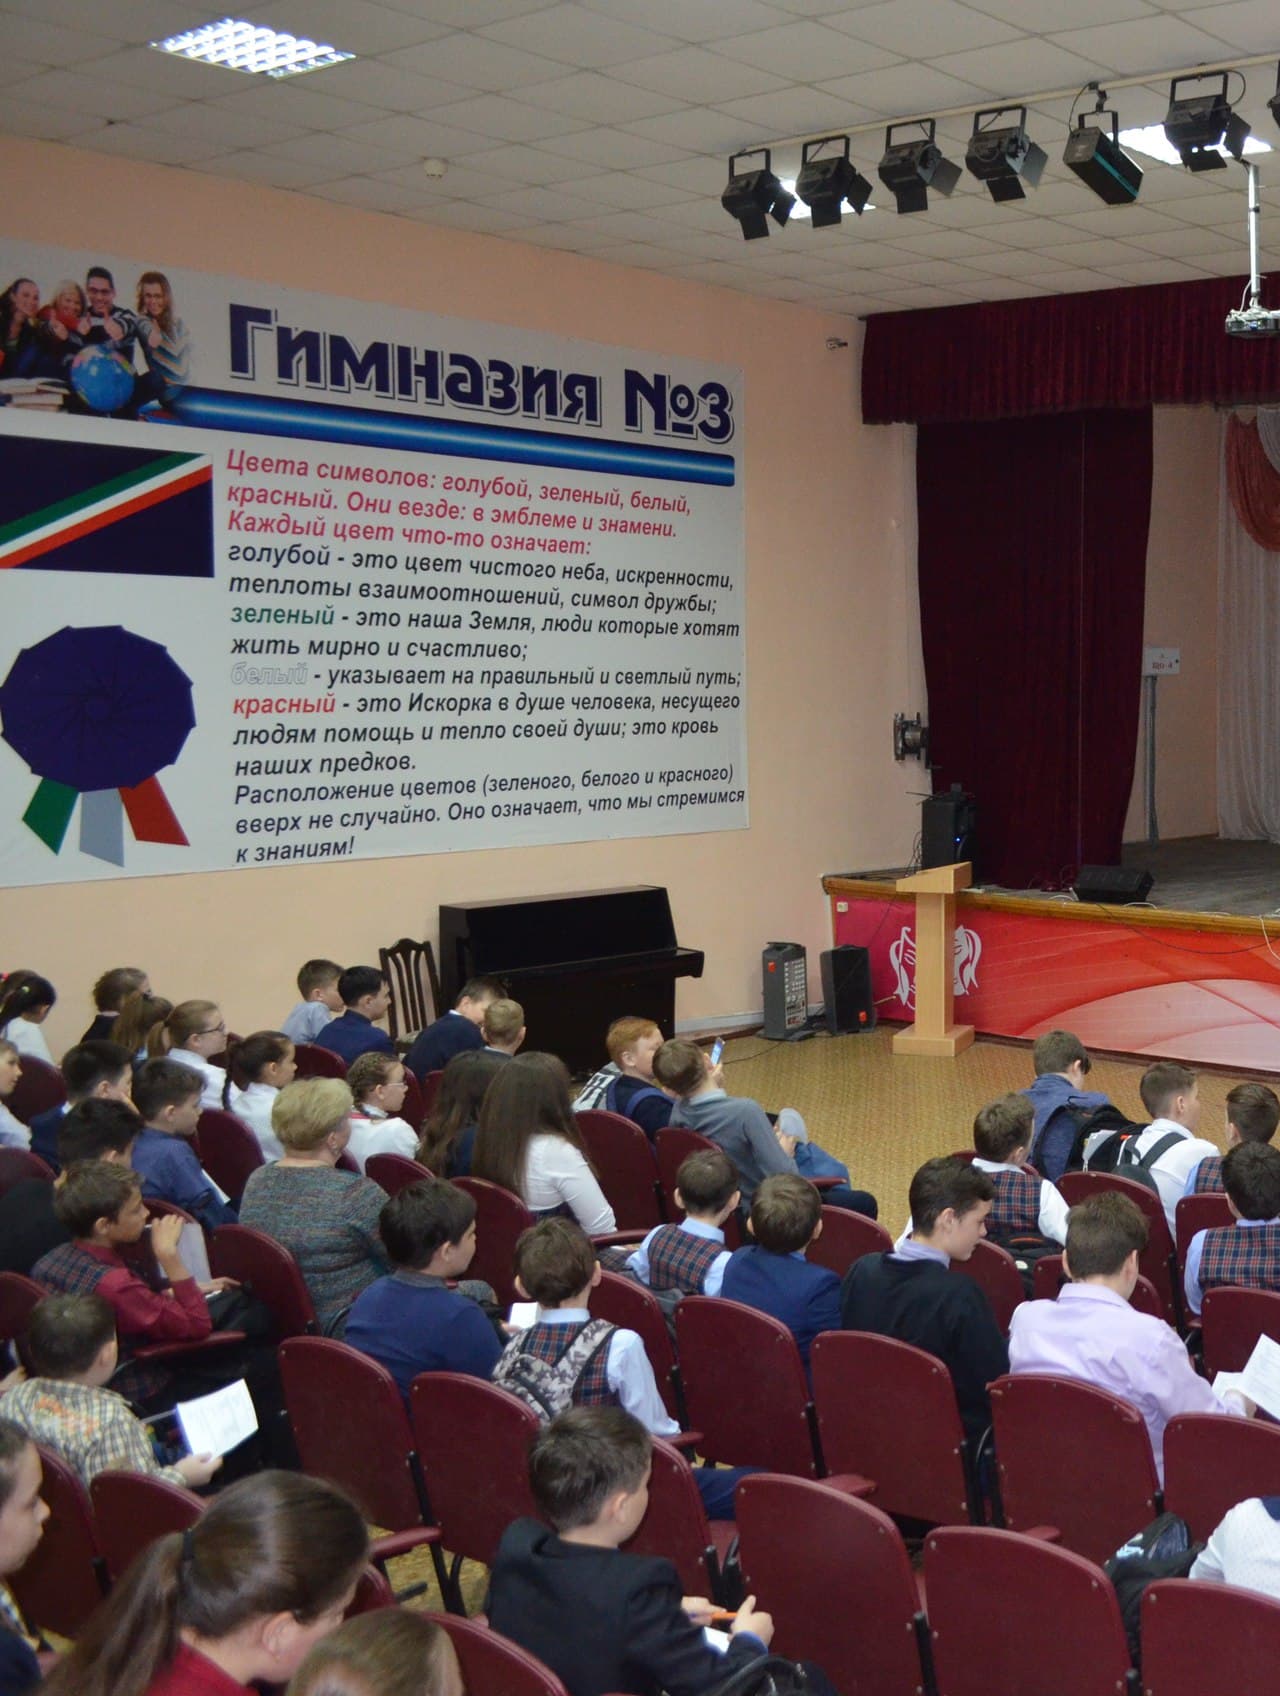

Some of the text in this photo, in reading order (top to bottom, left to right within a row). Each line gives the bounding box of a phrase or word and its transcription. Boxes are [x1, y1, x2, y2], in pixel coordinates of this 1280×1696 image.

[228, 302, 736, 444] Гимназия №3
[226, 448, 690, 517] Цвета символов: голубой, зеленый, белый,
[227, 485, 676, 538] красный. Они везде: в эмблеме и знамени.
[227, 509, 592, 556] Каждый цвет что-то означает:
[228, 542, 331, 569] голубой
[351, 552, 398, 570] это
[404, 555, 462, 576] цвет
[469, 559, 557, 581] чистого
[559, 561, 610, 585] неба,
[615, 567, 733, 592] искренности,
[228, 576, 717, 617] теплоты взаимоотношений, символ дружбы;
[230, 604, 335, 626] зеленый
[355, 609, 402, 628] это
[407, 612, 465, 631] наша
[466, 614, 536, 635] Земля,
[540, 613, 593, 633] люди
[597, 617, 681, 639] которые
[681, 621, 740, 637] хотят
[230, 638, 528, 663] жить мирно и счастливо;
[326, 668, 446, 690] указывает
[451, 669, 475, 685] на
[479, 662, 594, 689] правильный
[600, 671, 610, 685] и
[615, 666, 692, 686] светлый
[695, 671, 742, 690] путь;
[232, 692, 336, 720] красный
[356, 697, 402, 713] это
[408, 692, 493, 717] Искорка
[498, 697, 510, 712] в
[515, 692, 566, 714] душе
[571, 695, 656, 714] человека,
[661, 695, 740, 713] несущего
[232, 716, 719, 746] людям помощь и тепло своей души; это кровь
[234, 750, 416, 778] наших предков.
[234, 763, 735, 805] Расположение цветов (зеленого, белого и красного)
[235, 786, 745, 837] вверх не случайно. Оно означает, что мы стремимся
[235, 835, 356, 864] к знаниям!
